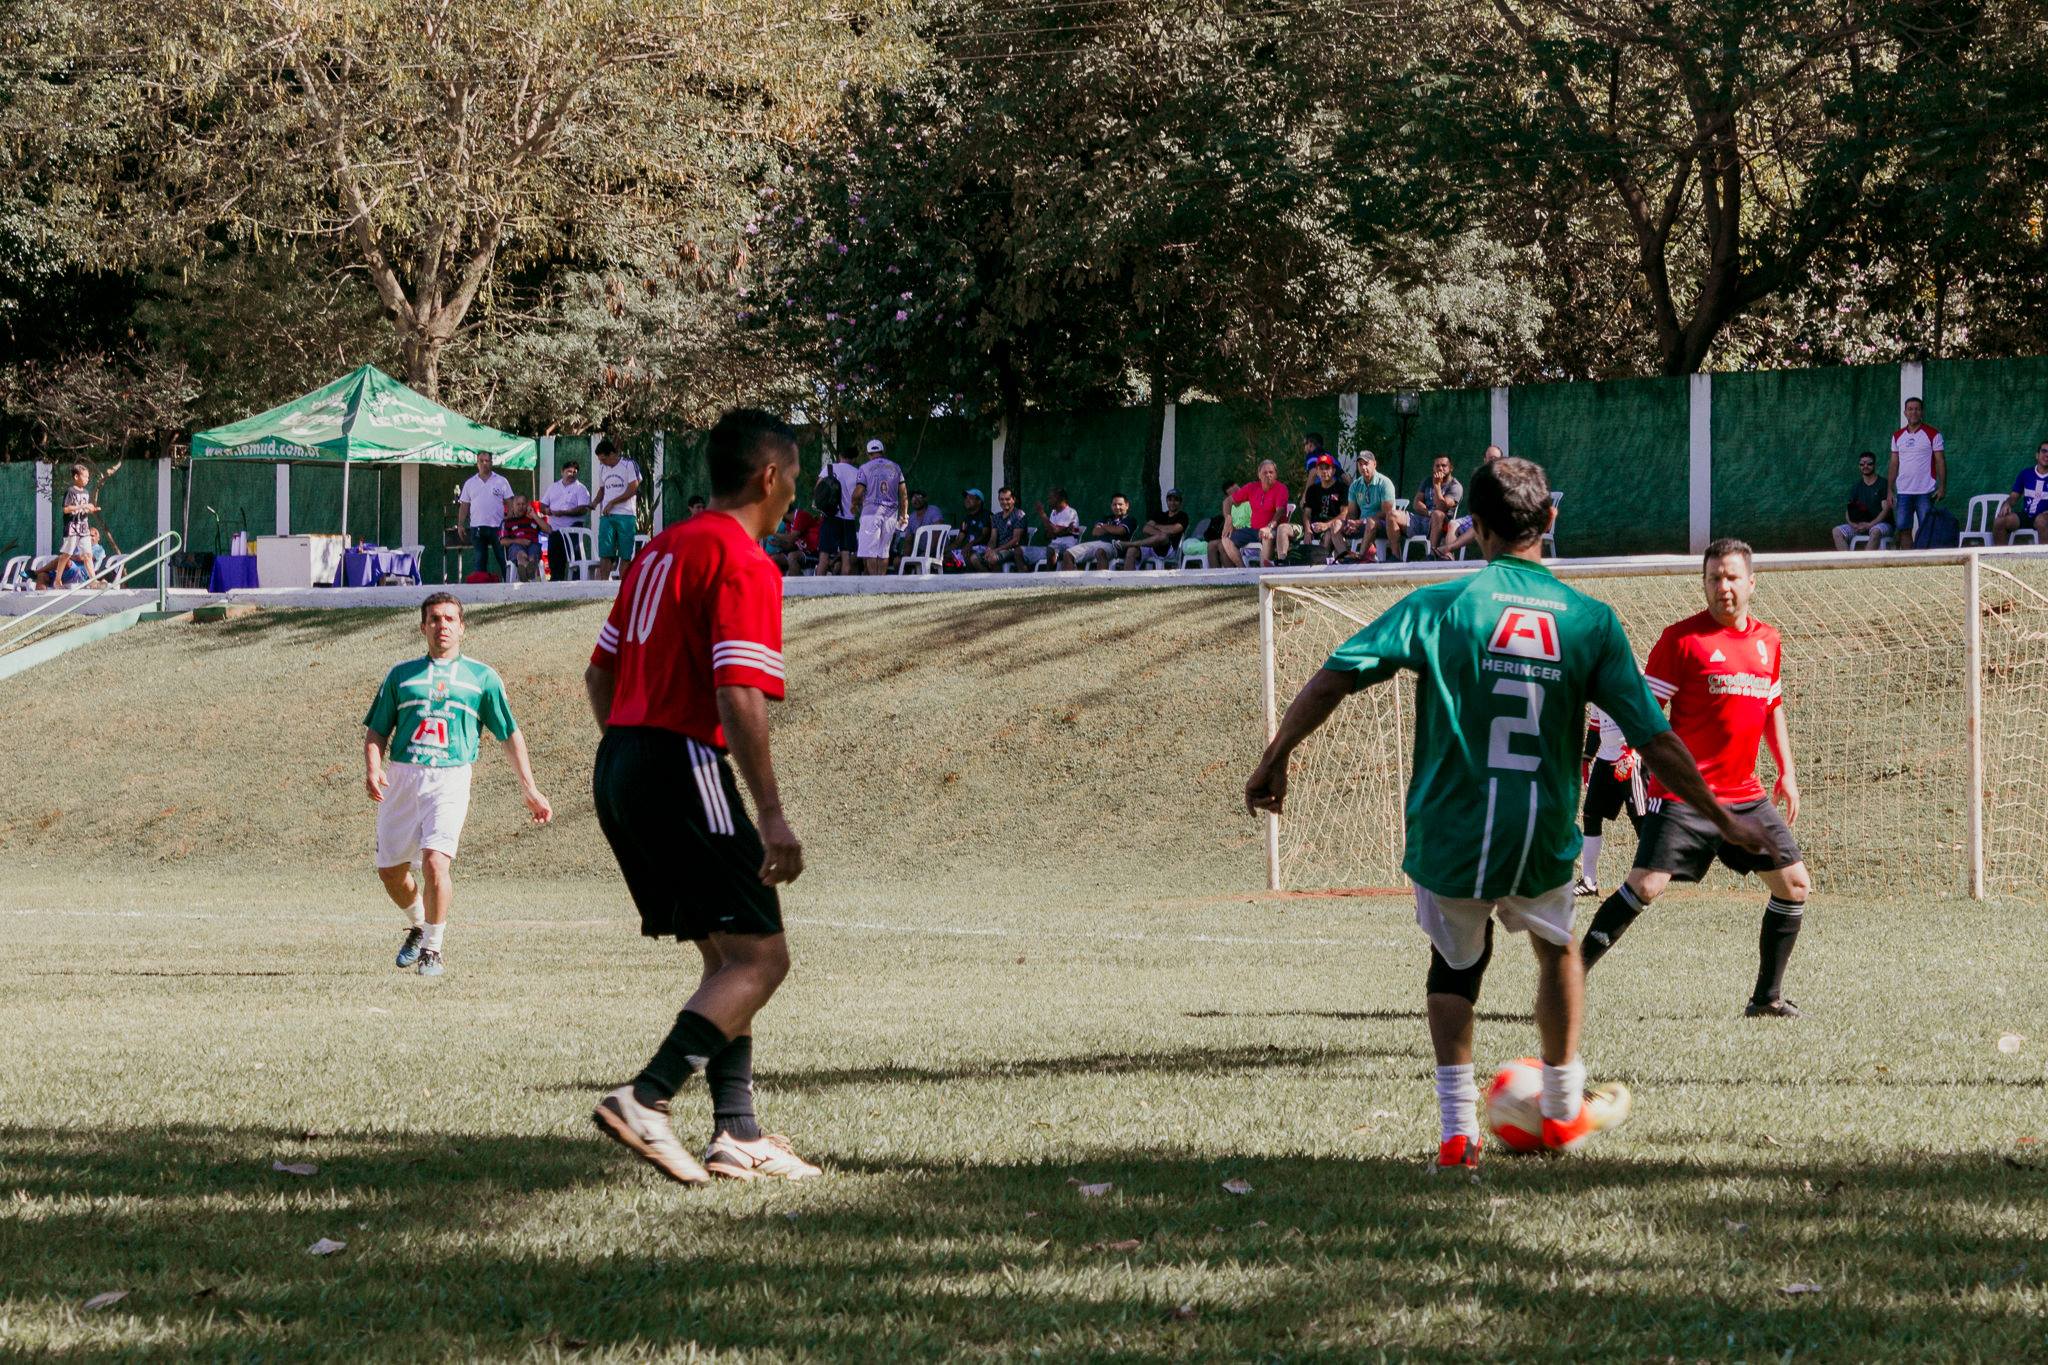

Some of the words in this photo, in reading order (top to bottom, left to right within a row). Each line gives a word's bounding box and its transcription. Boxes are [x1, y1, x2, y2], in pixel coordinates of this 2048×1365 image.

[626, 551, 673, 645] 10
[1492, 592, 1568, 612] FERTILIZANTES
[1481, 659, 1562, 681] HERINGER
[1487, 678, 1545, 772] 2
